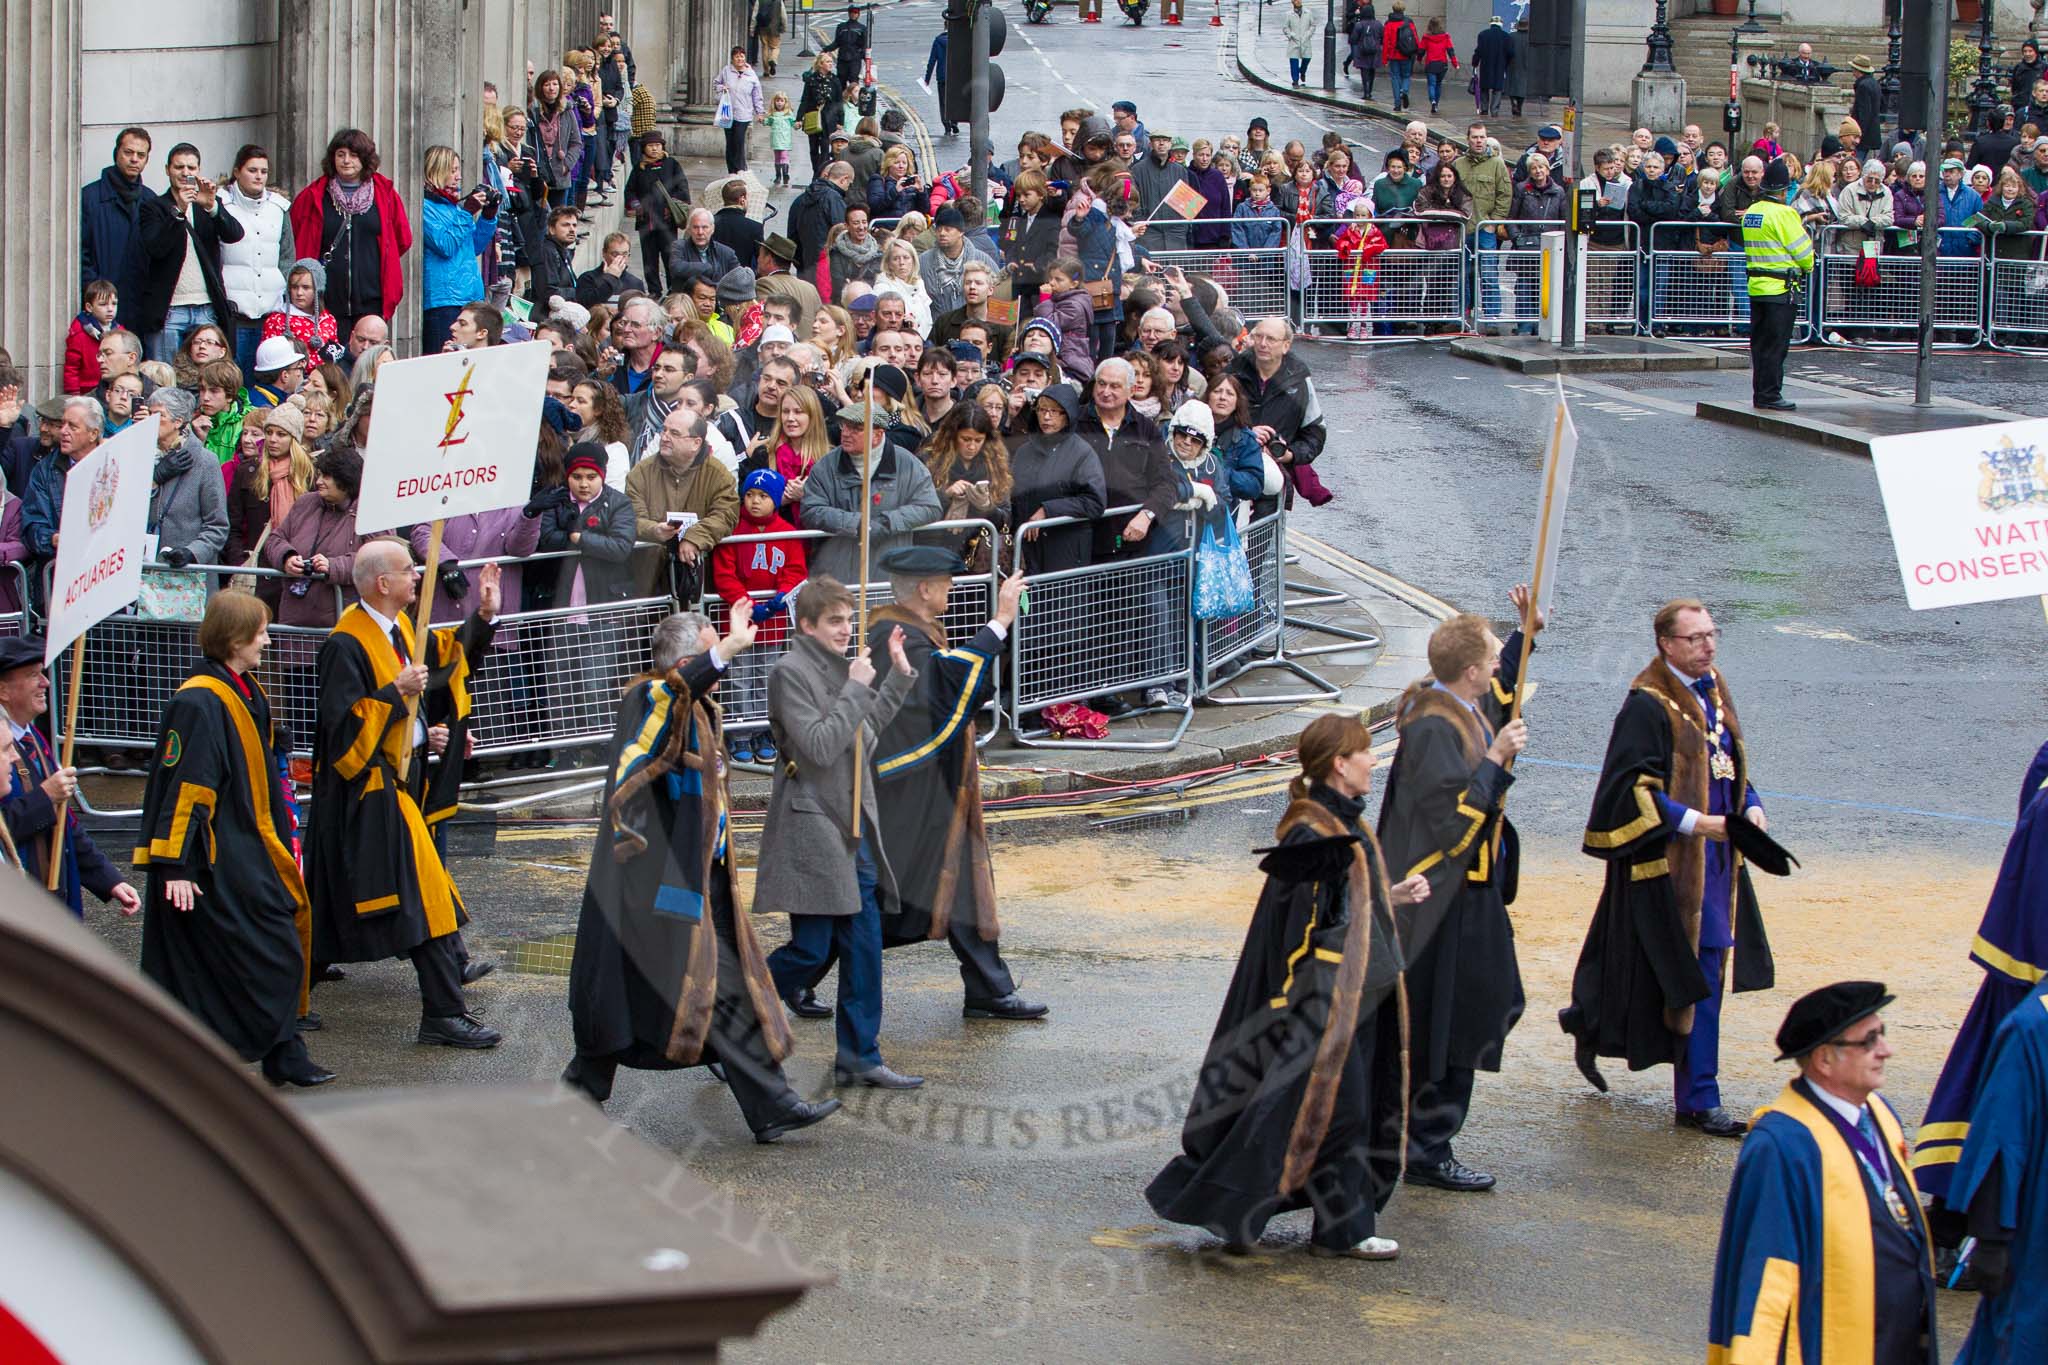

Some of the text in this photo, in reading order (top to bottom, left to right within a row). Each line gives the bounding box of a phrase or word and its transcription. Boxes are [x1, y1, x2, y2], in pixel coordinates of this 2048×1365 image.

[396, 464, 498, 499] EDUCATORS
[1974, 519, 2048, 548] WAT
[63, 547, 127, 609] ACTUARIES
